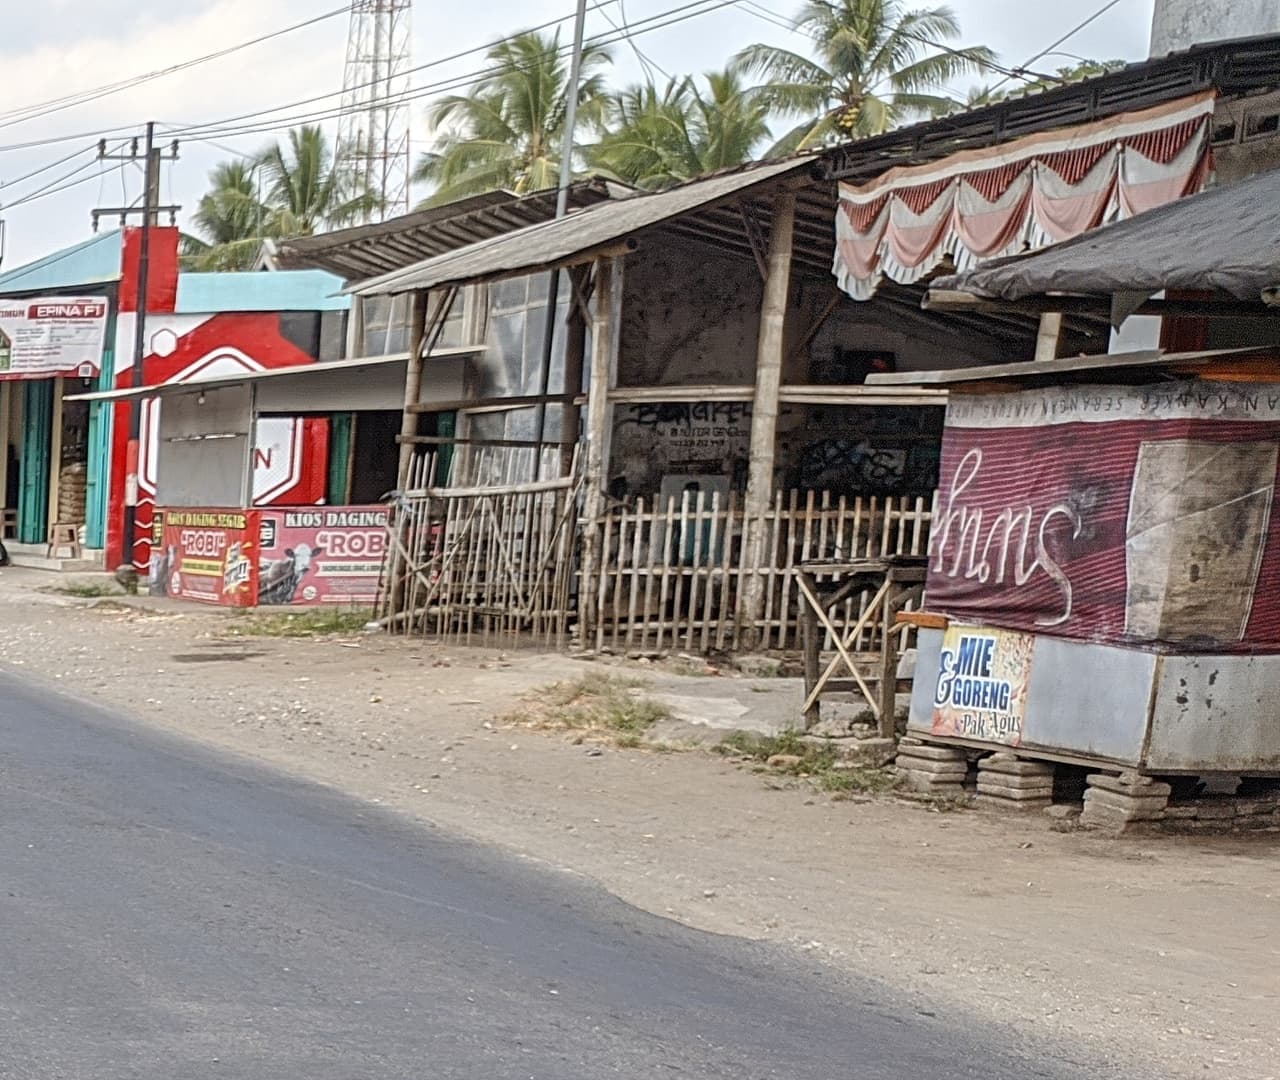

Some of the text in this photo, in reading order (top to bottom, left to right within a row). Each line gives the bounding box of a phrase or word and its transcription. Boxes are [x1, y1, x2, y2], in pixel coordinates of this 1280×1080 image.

[36, 305, 81, 318] ERINA
[83, 303, 101, 317] F1
[285, 511, 386, 527] KIOS DAGING
[961, 637, 995, 678] MIE
[952, 677, 1010, 711] GORENG
[962, 711, 986, 739] Pak
